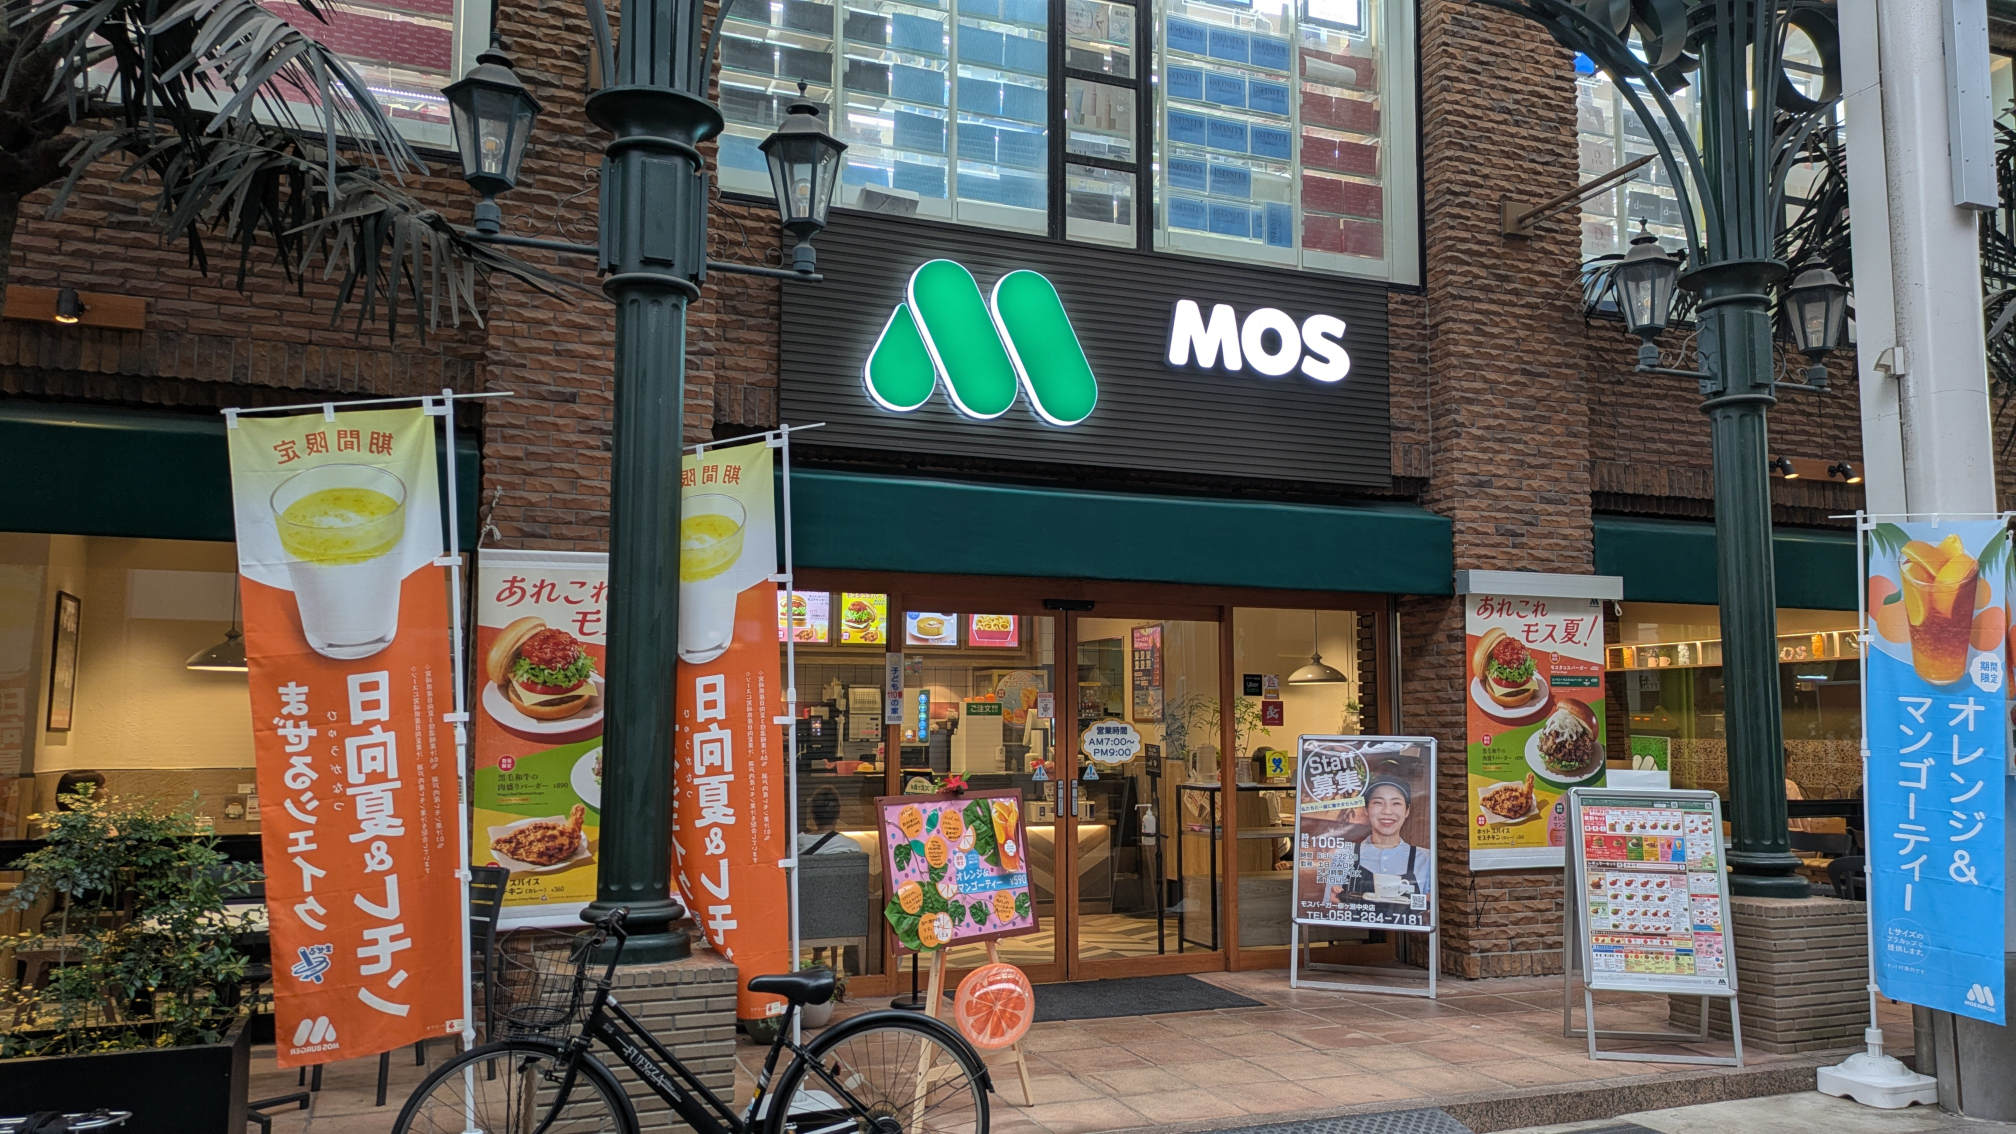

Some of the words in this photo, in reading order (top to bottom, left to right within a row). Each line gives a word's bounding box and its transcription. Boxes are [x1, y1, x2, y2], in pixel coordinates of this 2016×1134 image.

[1168, 299, 1351, 382] MOS
[1476, 595, 1549, 620] あれこれ
[571, 608, 607, 637] モ
[1780, 646, 1808, 661] OS
[1096, 726, 1128, 735] 営業時間
[1093, 748, 1132, 757] PM9:00
[1308, 750, 1355, 775] Staff
[1310, 767, 1364, 799] 募集
[1947, 696, 1987, 886] オレンジ&
[1893, 695, 1937, 912] マンゴーティー
[957, 879, 1003, 893] マンゴーティー
